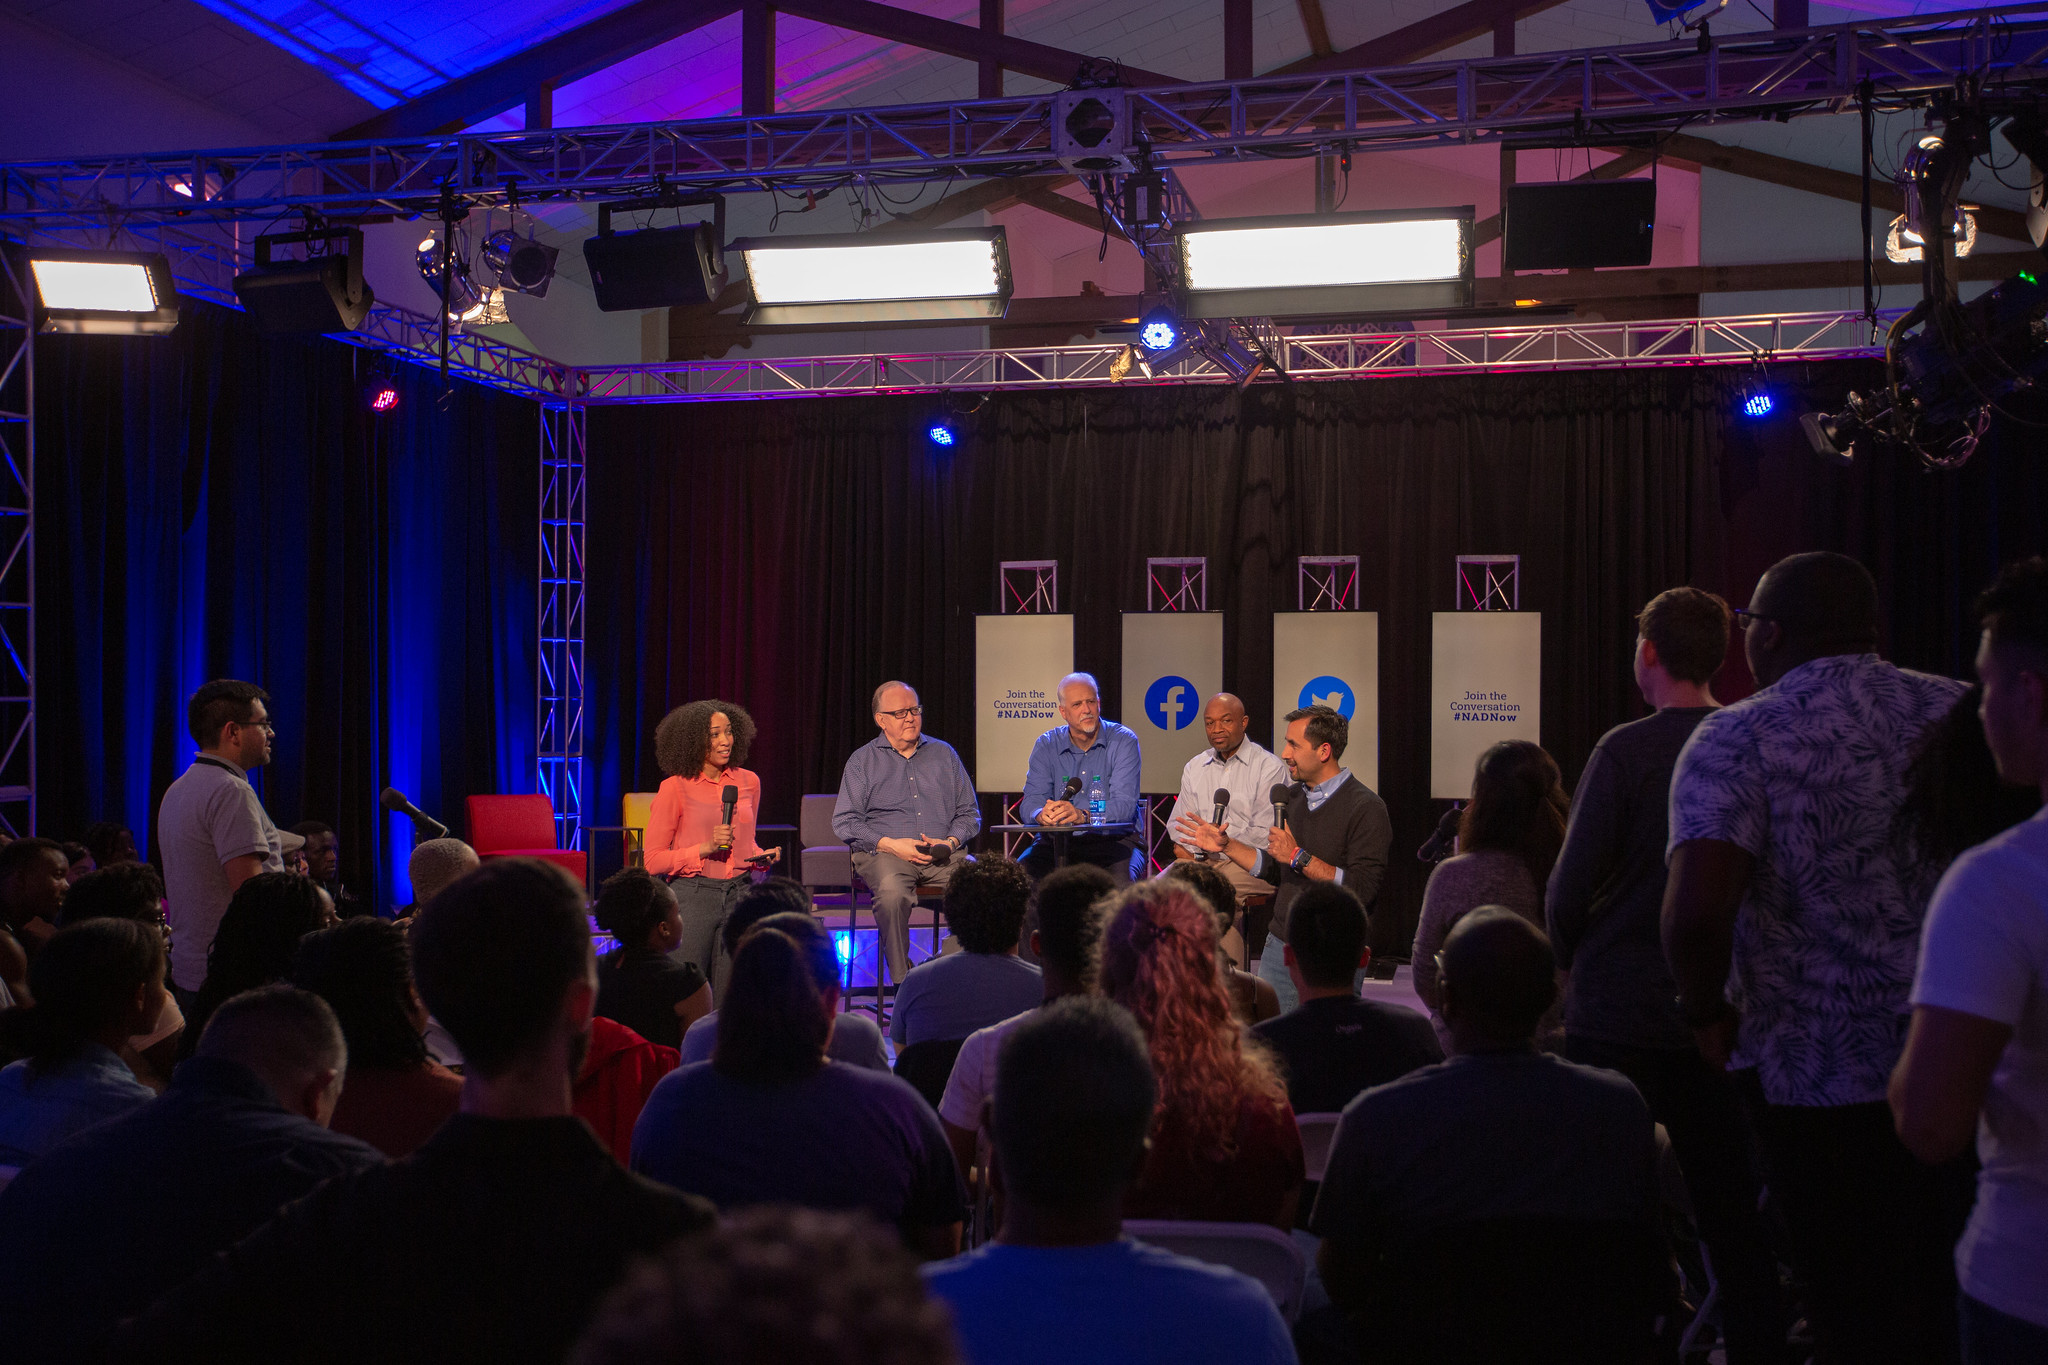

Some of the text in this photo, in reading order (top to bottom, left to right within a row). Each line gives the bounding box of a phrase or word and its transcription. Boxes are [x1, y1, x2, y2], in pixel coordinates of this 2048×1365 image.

[1006, 690, 1045, 699] Join the
[1464, 691, 1507, 700] Join the
[993, 700, 1058, 709] Conversation
[1450, 701, 1521, 711] Conversation
[997, 710, 1054, 719] #NADNow
[1454, 712, 1517, 721] #NADNow
